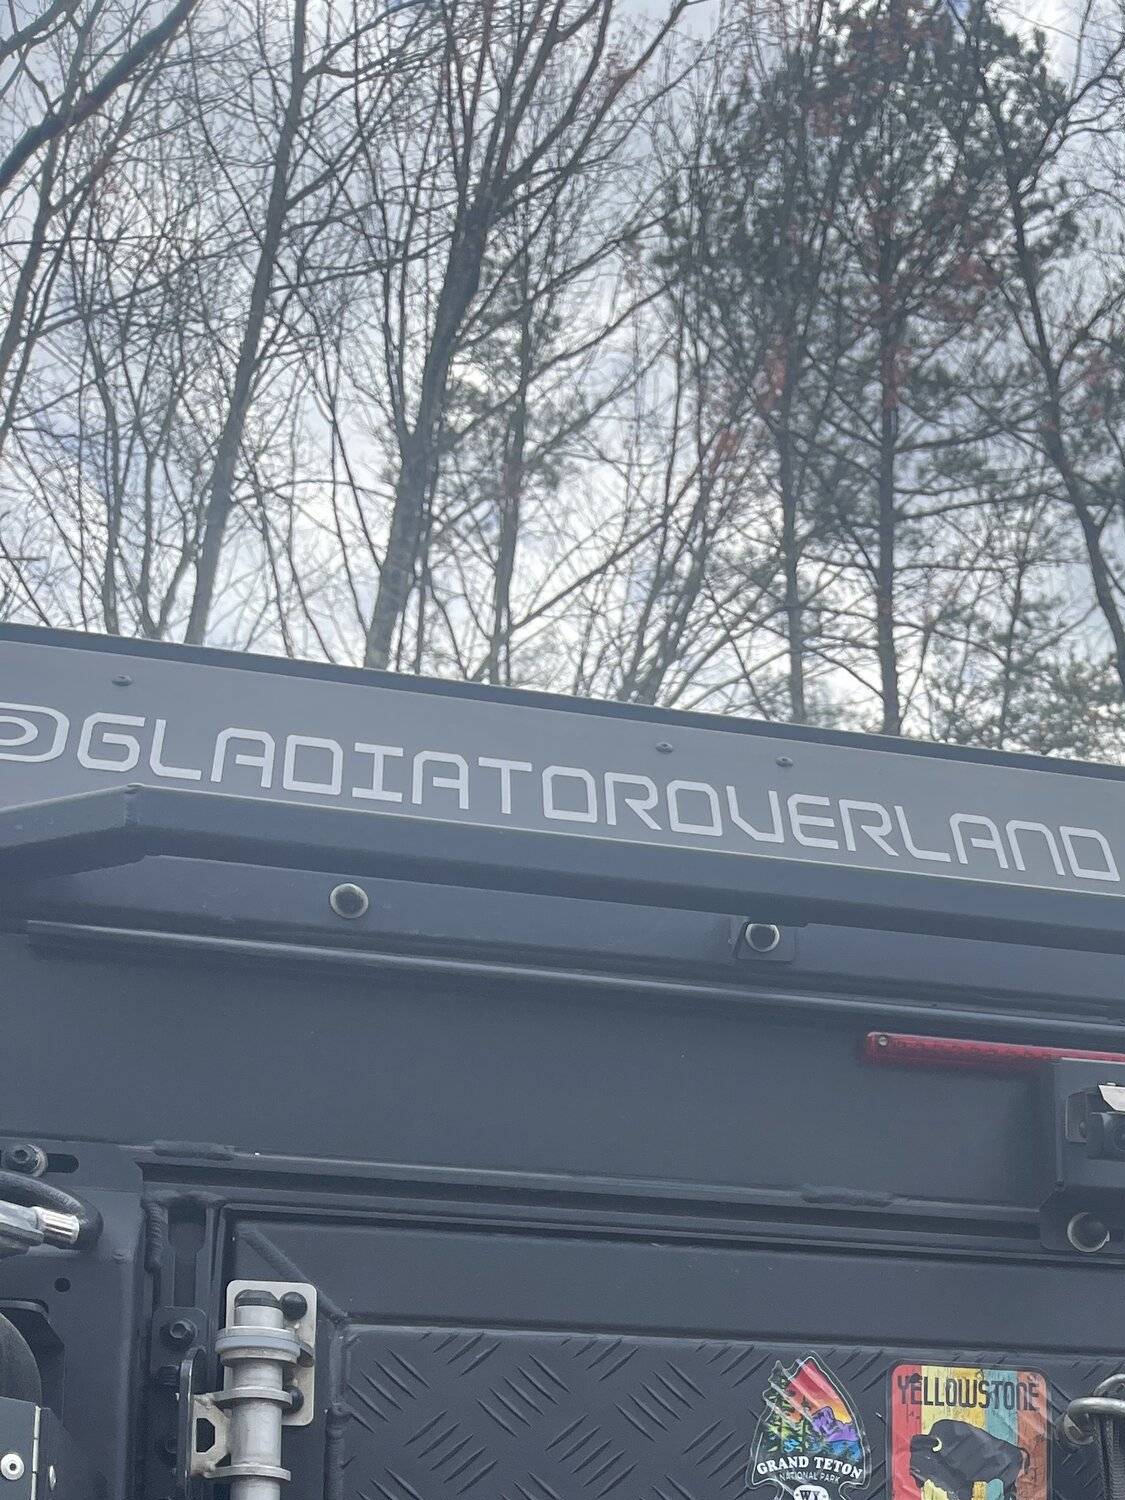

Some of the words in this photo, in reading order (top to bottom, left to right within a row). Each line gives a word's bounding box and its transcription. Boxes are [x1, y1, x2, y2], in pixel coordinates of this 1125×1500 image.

[756, 1456, 809, 1475] GRAND
[813, 1456, 864, 1479] TETON
[779, 1472, 818, 1481] NATIONAL
[820, 1473, 841, 1484] PARK
